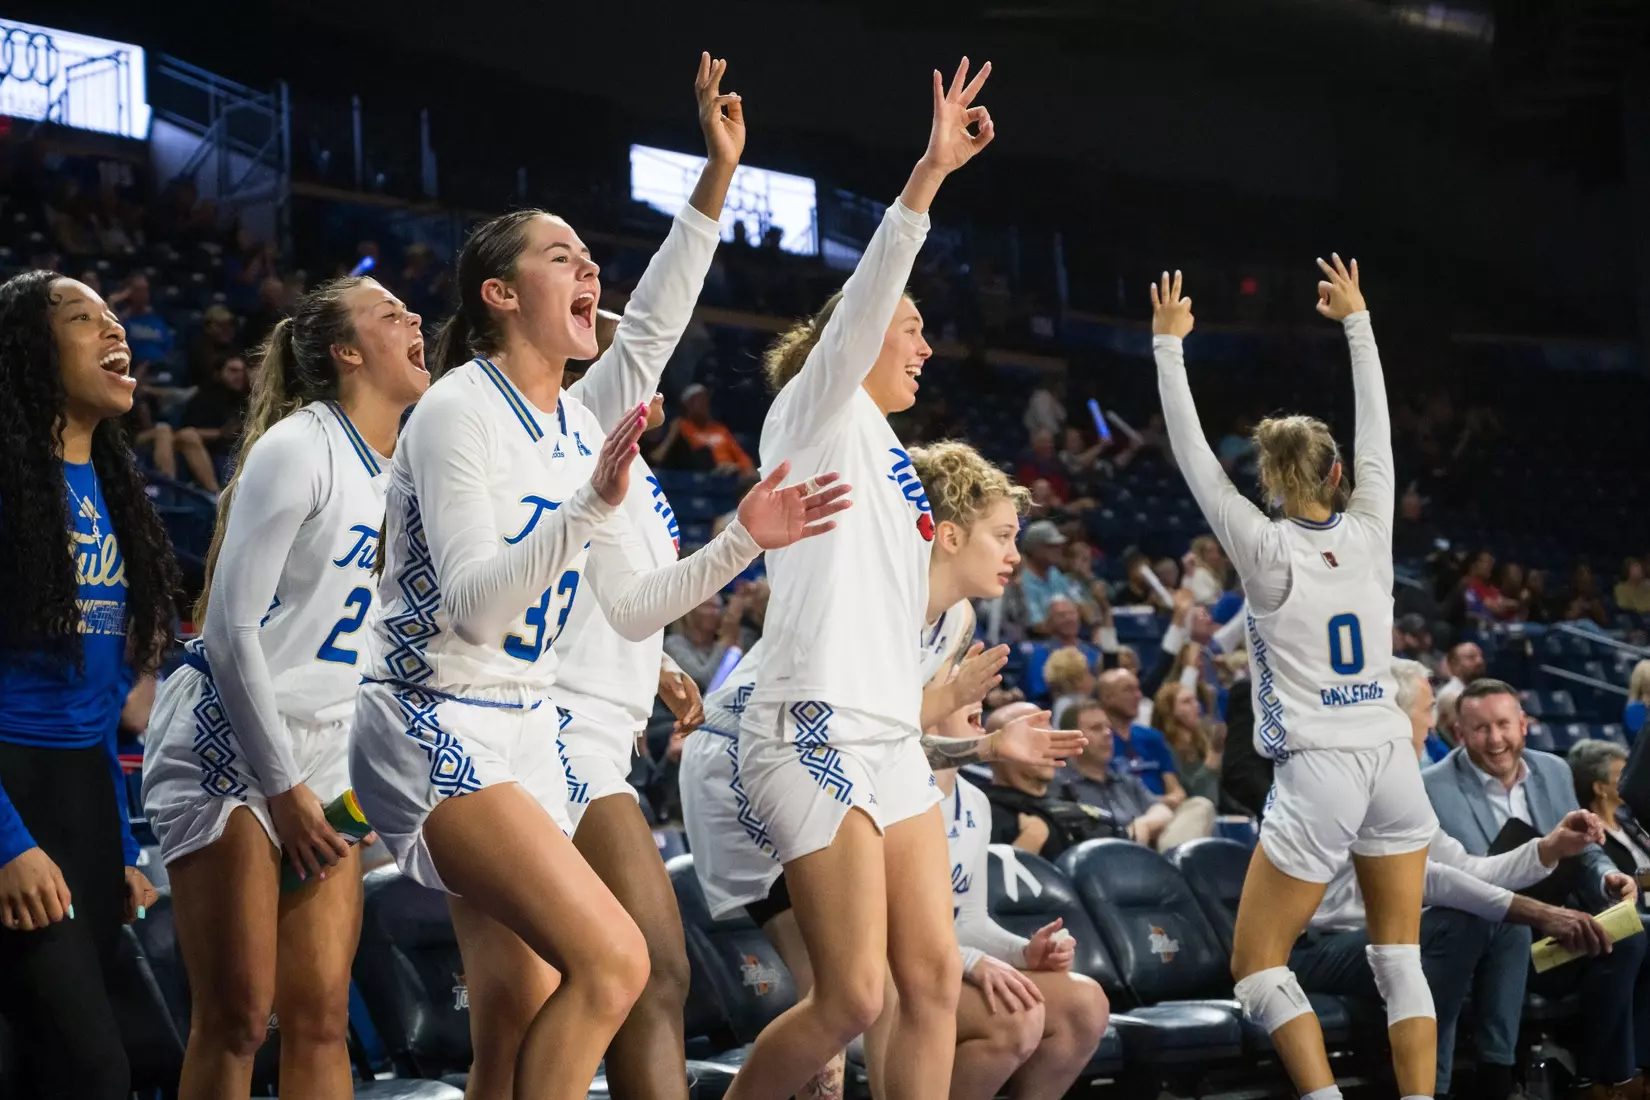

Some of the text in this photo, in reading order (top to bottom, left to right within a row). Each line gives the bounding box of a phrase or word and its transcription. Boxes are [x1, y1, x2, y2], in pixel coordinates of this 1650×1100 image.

[315, 584, 374, 667] 2
[502, 568, 581, 665] 33
[1326, 611, 1366, 677] 0
